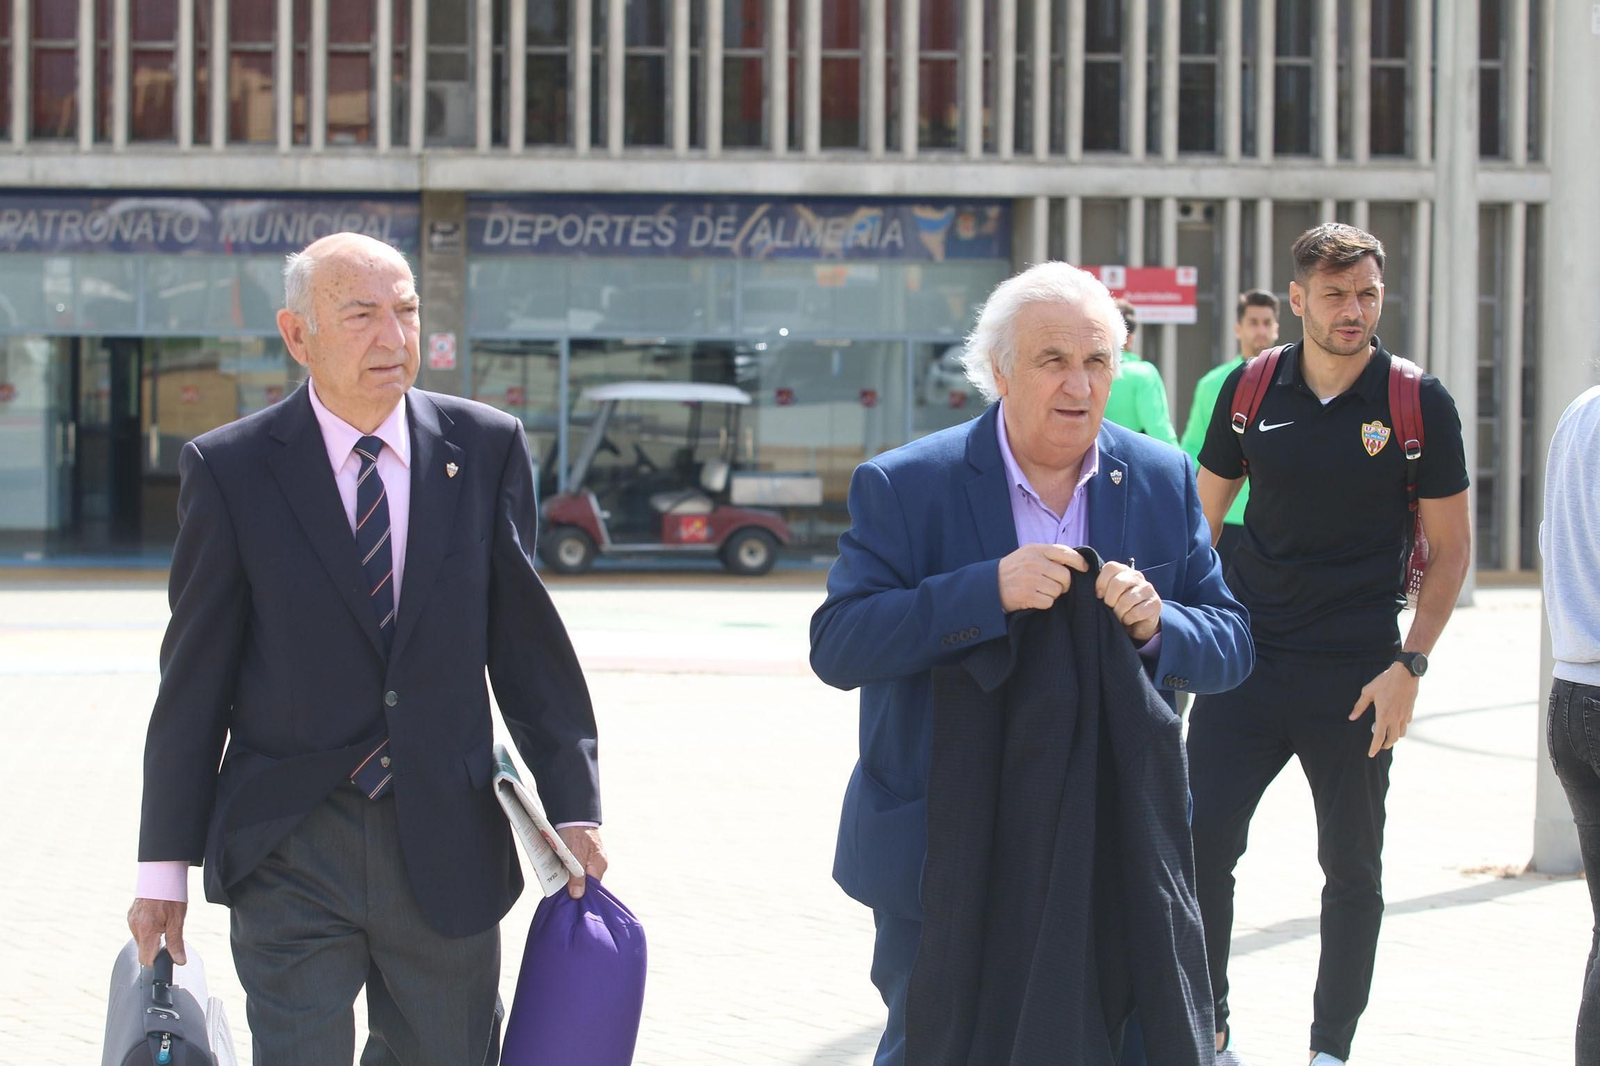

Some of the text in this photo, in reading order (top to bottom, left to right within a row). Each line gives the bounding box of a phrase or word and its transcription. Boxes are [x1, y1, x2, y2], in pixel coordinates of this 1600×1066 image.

[0, 209, 398, 244] PATRONATO MUNICIPAL
[483, 213, 677, 246] DEPORTES
[688, 215, 738, 247] DE
